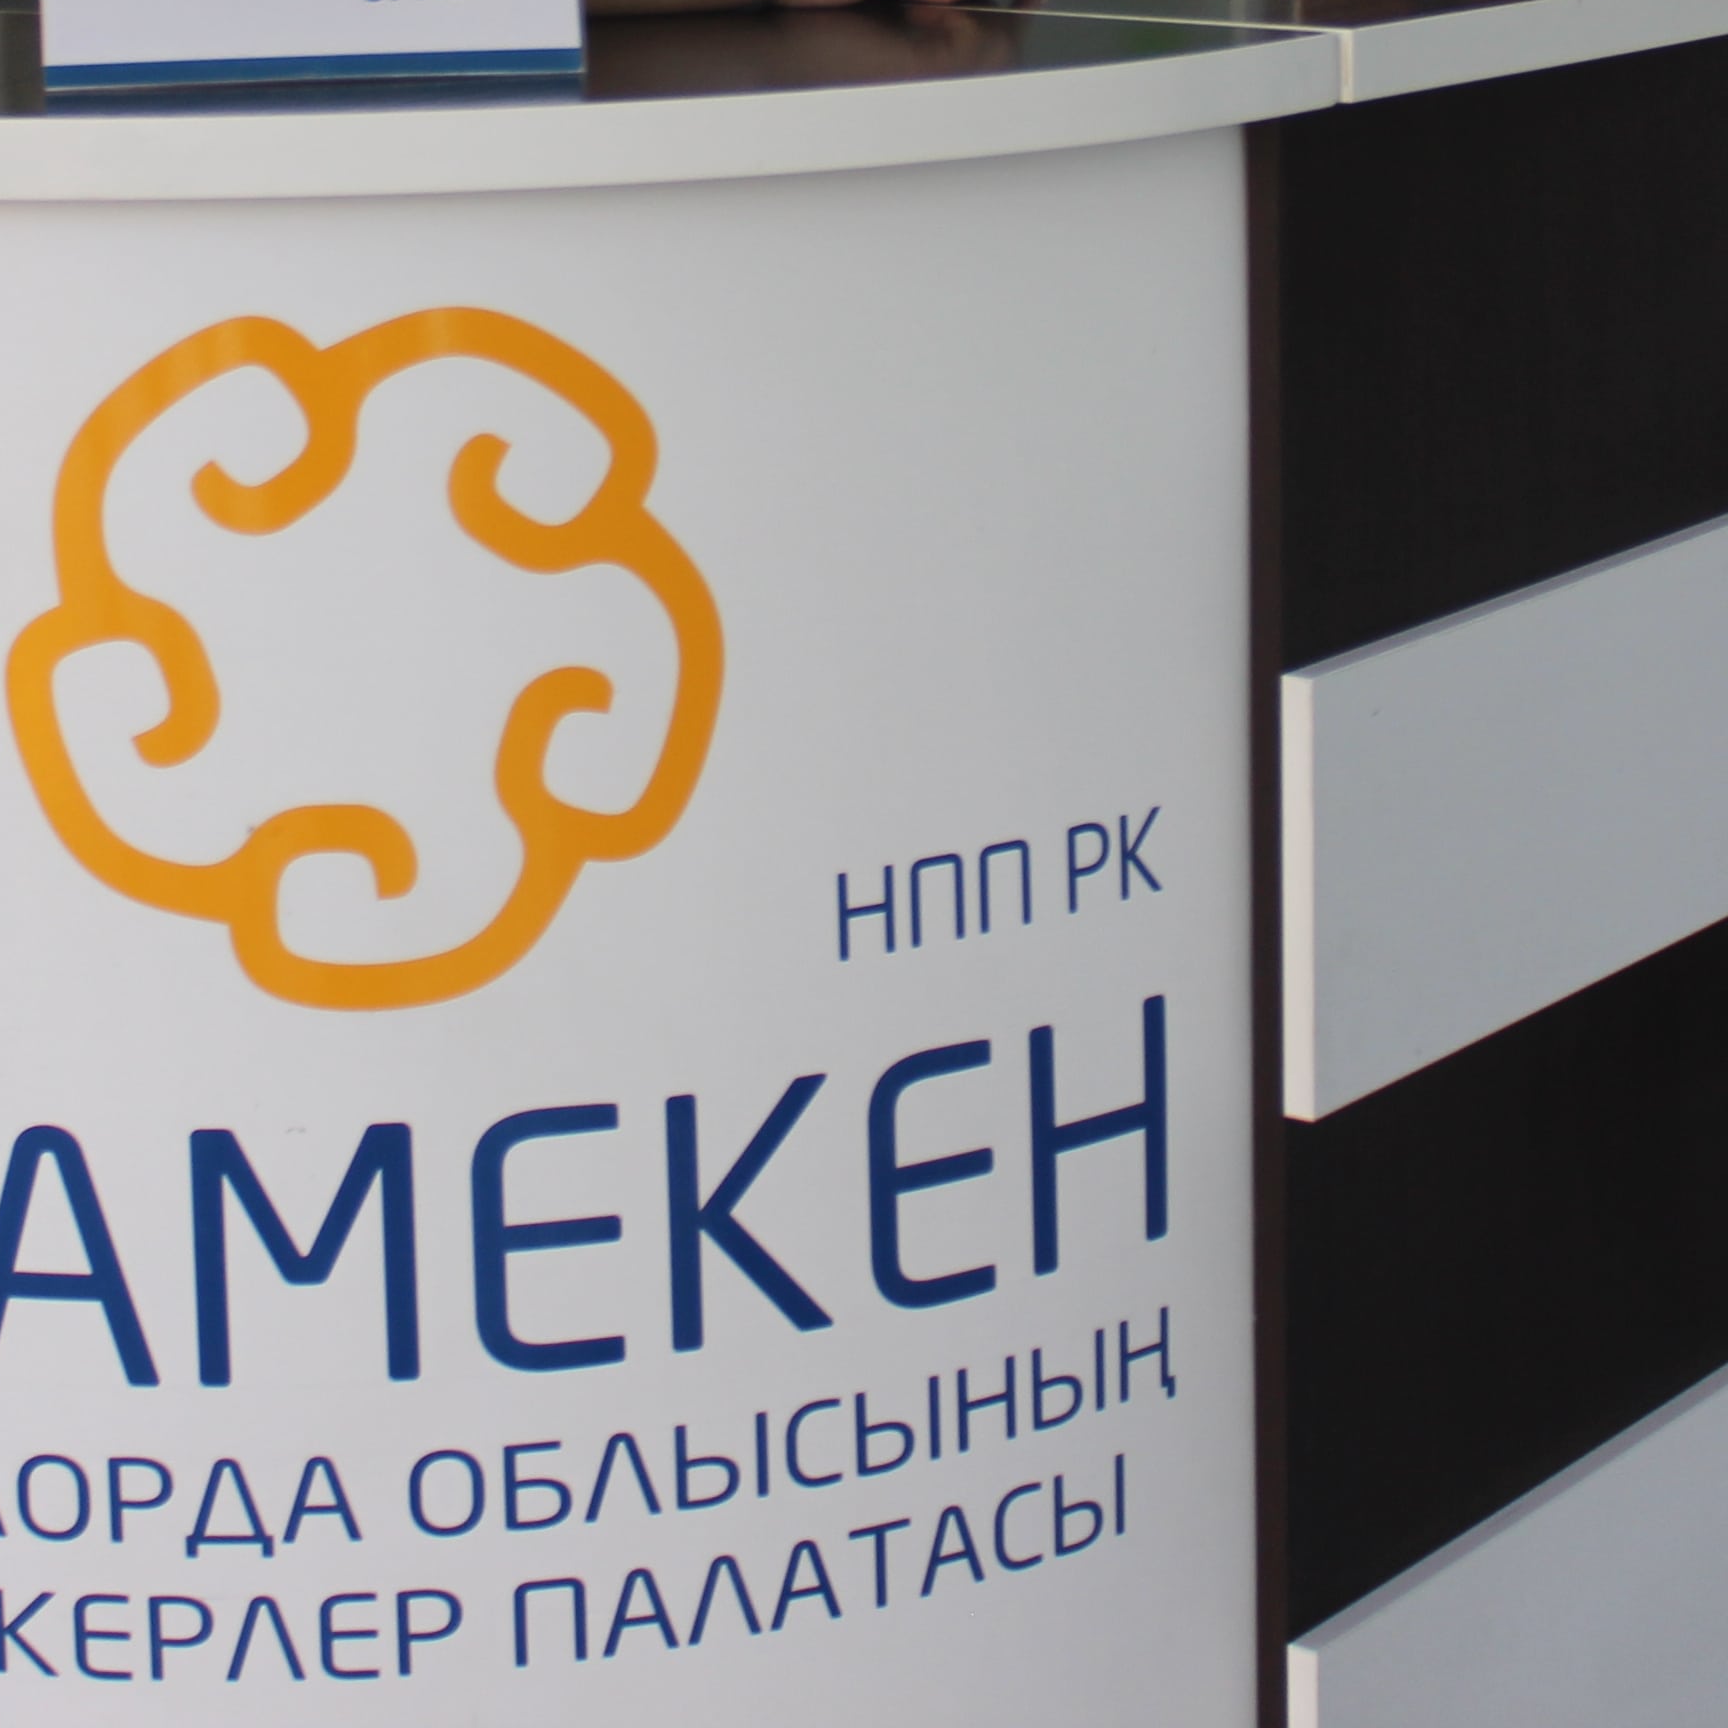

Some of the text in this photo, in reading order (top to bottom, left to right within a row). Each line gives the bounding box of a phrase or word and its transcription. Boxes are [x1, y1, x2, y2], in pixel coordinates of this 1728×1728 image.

[838, 806, 1162, 961] НПП РК
[405, 1305, 1177, 1536] ОБЛЫСЫНЫҢ
[512, 1453, 1126, 1668] ПАЛАТАСЫ
